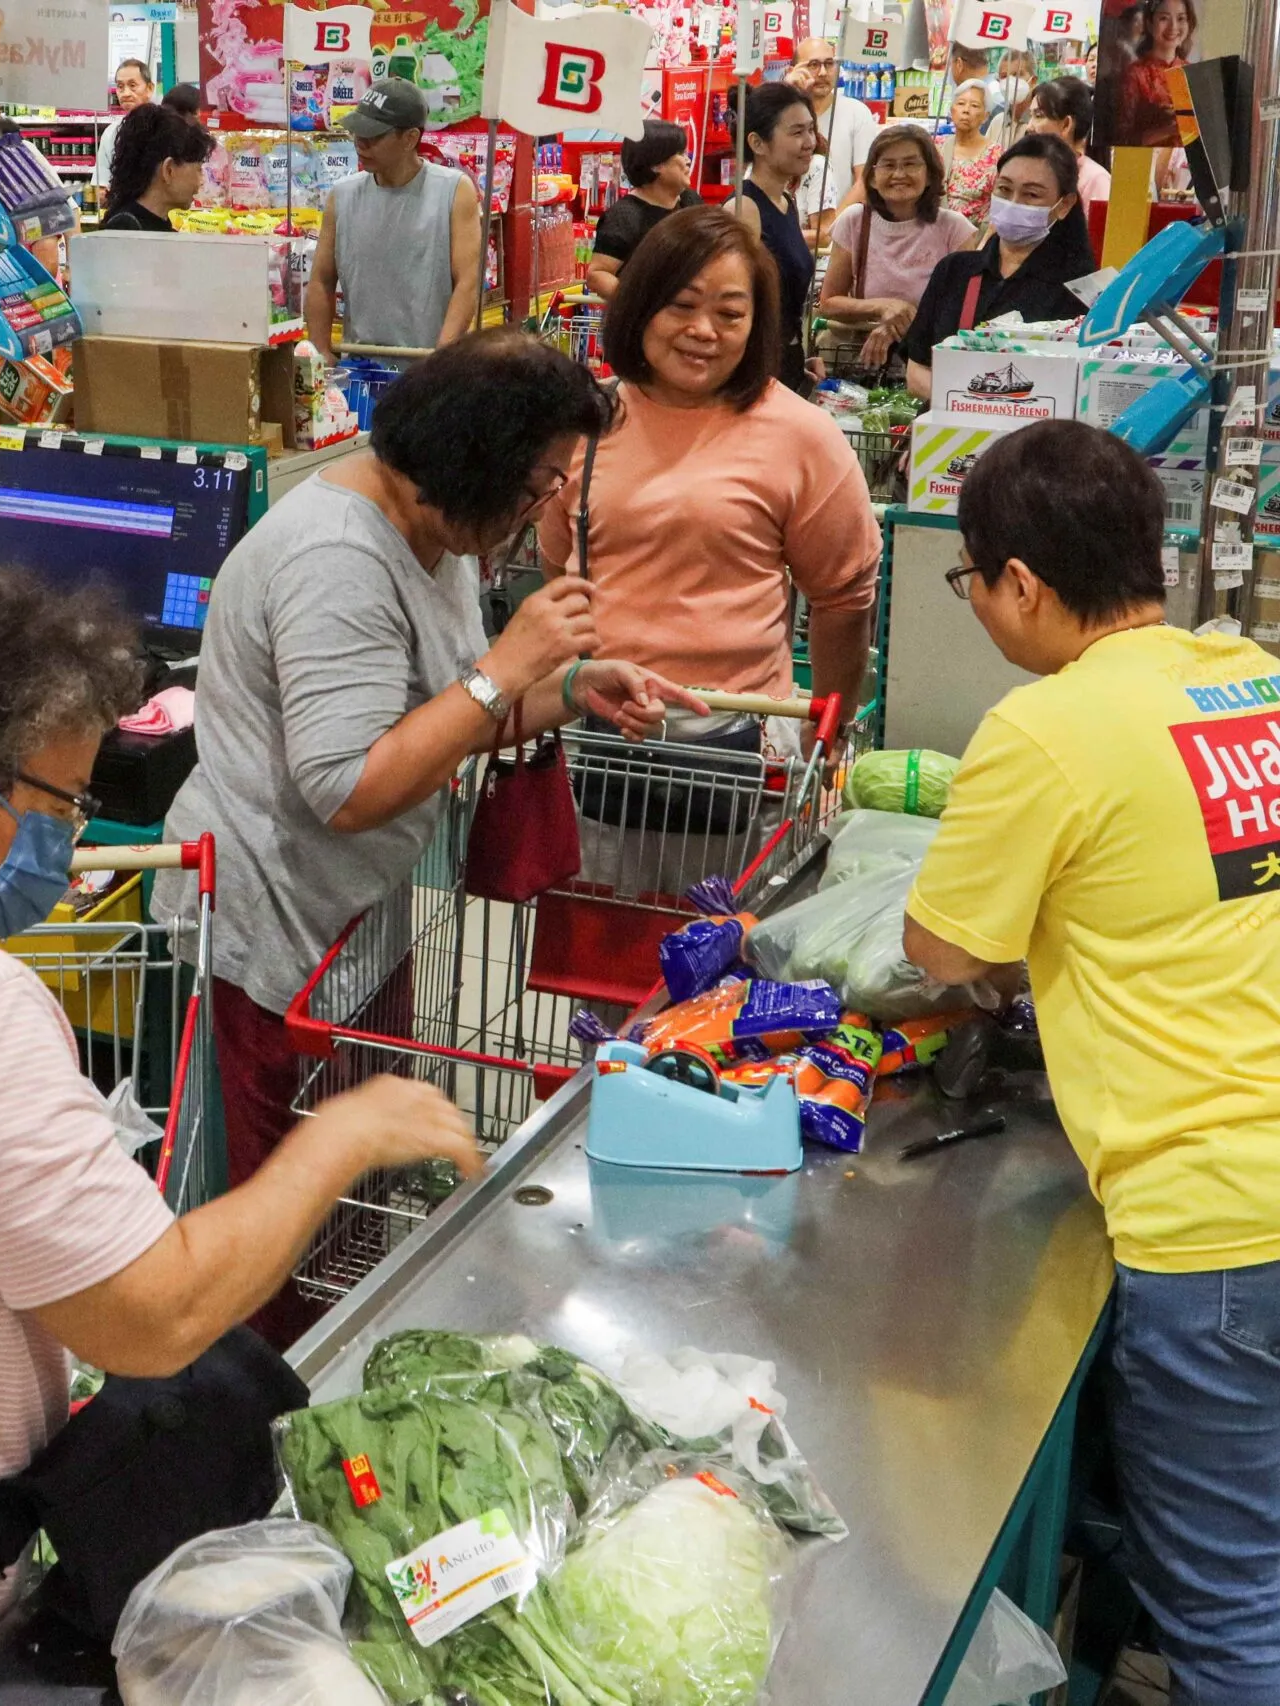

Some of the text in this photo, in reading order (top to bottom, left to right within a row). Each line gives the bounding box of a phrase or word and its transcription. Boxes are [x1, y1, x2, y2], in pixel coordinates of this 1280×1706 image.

[861, 49, 887, 57] BILLION
[296, 81, 313, 92] BREEZE
[332, 87, 354, 99] BREEZE
[240, 155, 260, 167] BREEZE
[327, 156, 349, 167] BREEZE
[951, 400, 1049, 418] FISHERMAN'S FRIEND
[193, 467, 233, 491] 3.11
[1185, 674, 1280, 713] BILLIO
[800, 1046, 867, 1084] Fresh Carrots
[439, 1540, 495, 1575] TANG HO
